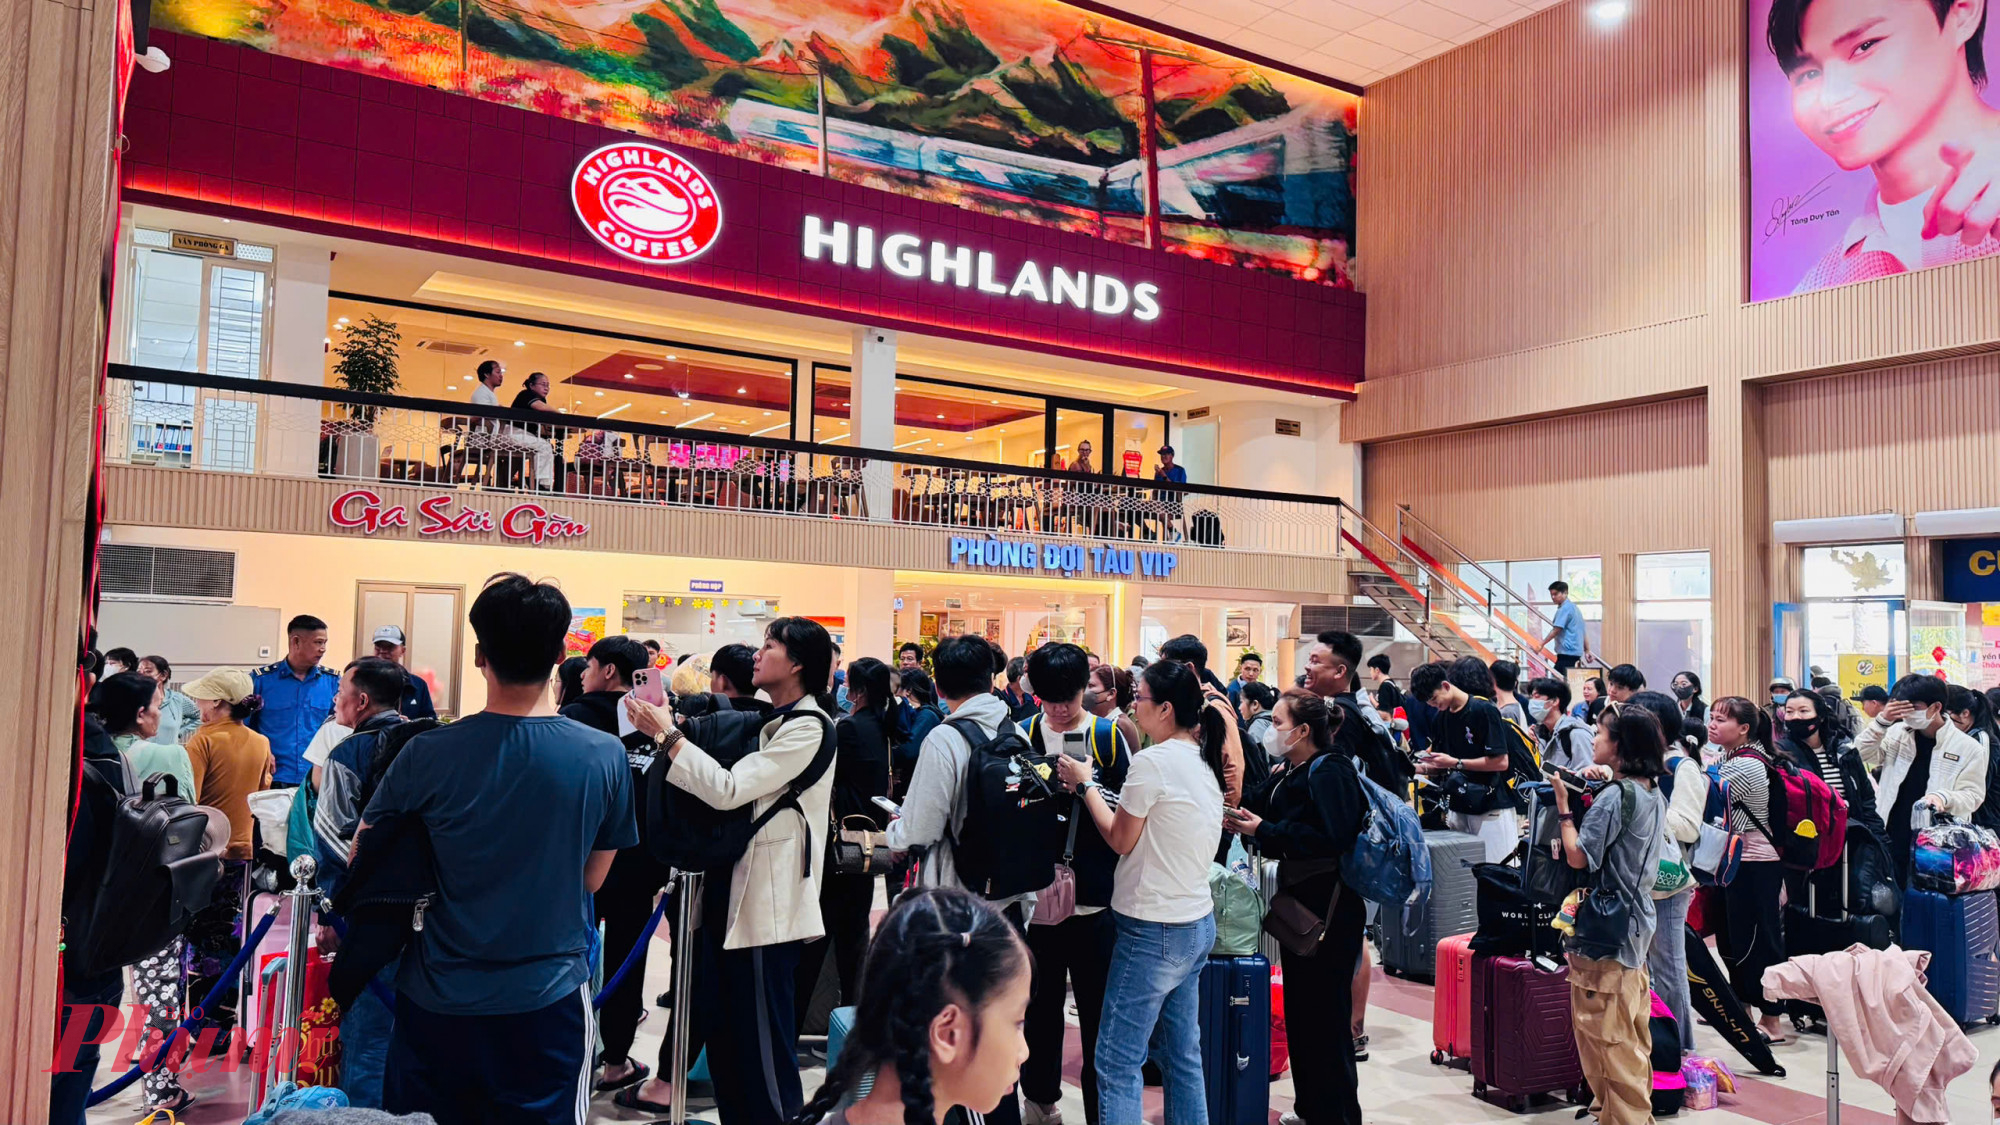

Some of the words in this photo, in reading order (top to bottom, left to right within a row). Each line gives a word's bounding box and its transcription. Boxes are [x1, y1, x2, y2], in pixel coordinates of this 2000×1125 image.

[583, 150, 713, 209] HIGHLANDS
[1810, 213, 1825, 221] Duy
[598, 220, 698, 257] COFFEE
[803, 214, 1161, 321] HIGHLANDS
[330, 489, 409, 534] Ga
[418, 495, 495, 535] Sài
[500, 503, 592, 545] Gòn
[950, 533, 1038, 569] PHÒNG
[1044, 543, 1085, 577] ĐỢI
[1091, 543, 1135, 576] TÀU
[1139, 550, 1178, 577] VIP
[1968, 549, 2000, 576] C
[1856, 660, 1874, 675] C2
[1501, 911, 1530, 920] WORL
